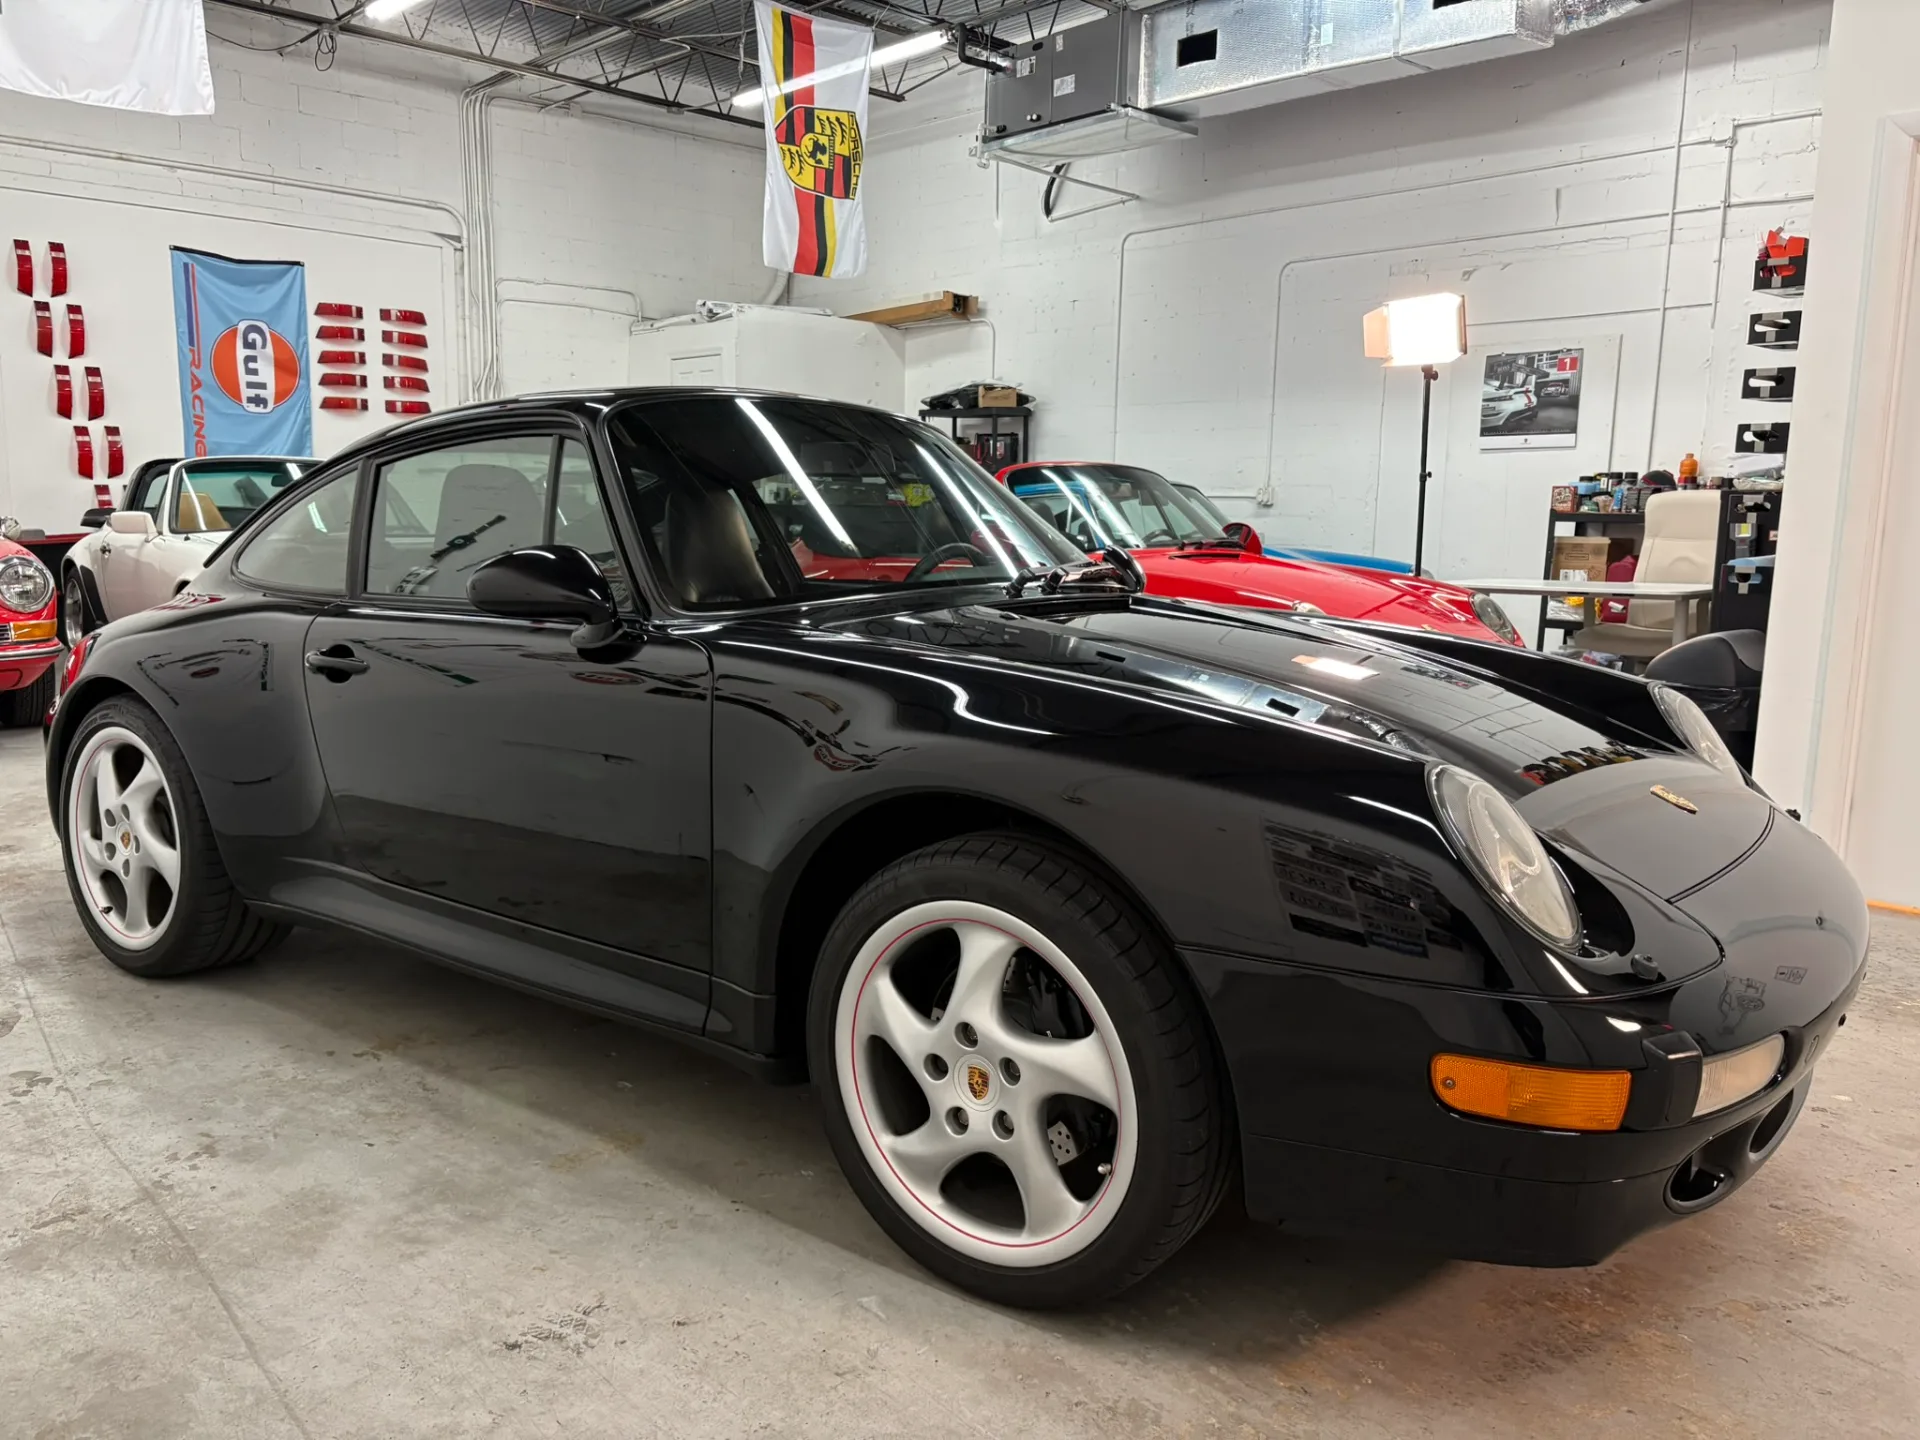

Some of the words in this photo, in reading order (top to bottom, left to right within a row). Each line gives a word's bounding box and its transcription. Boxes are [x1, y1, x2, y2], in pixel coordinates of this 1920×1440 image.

[849, 114, 861, 198] PORSCHE
[189, 347, 208, 458] RACING
[242, 324, 268, 409] Gulf
[1563, 357, 1571, 371] 1
